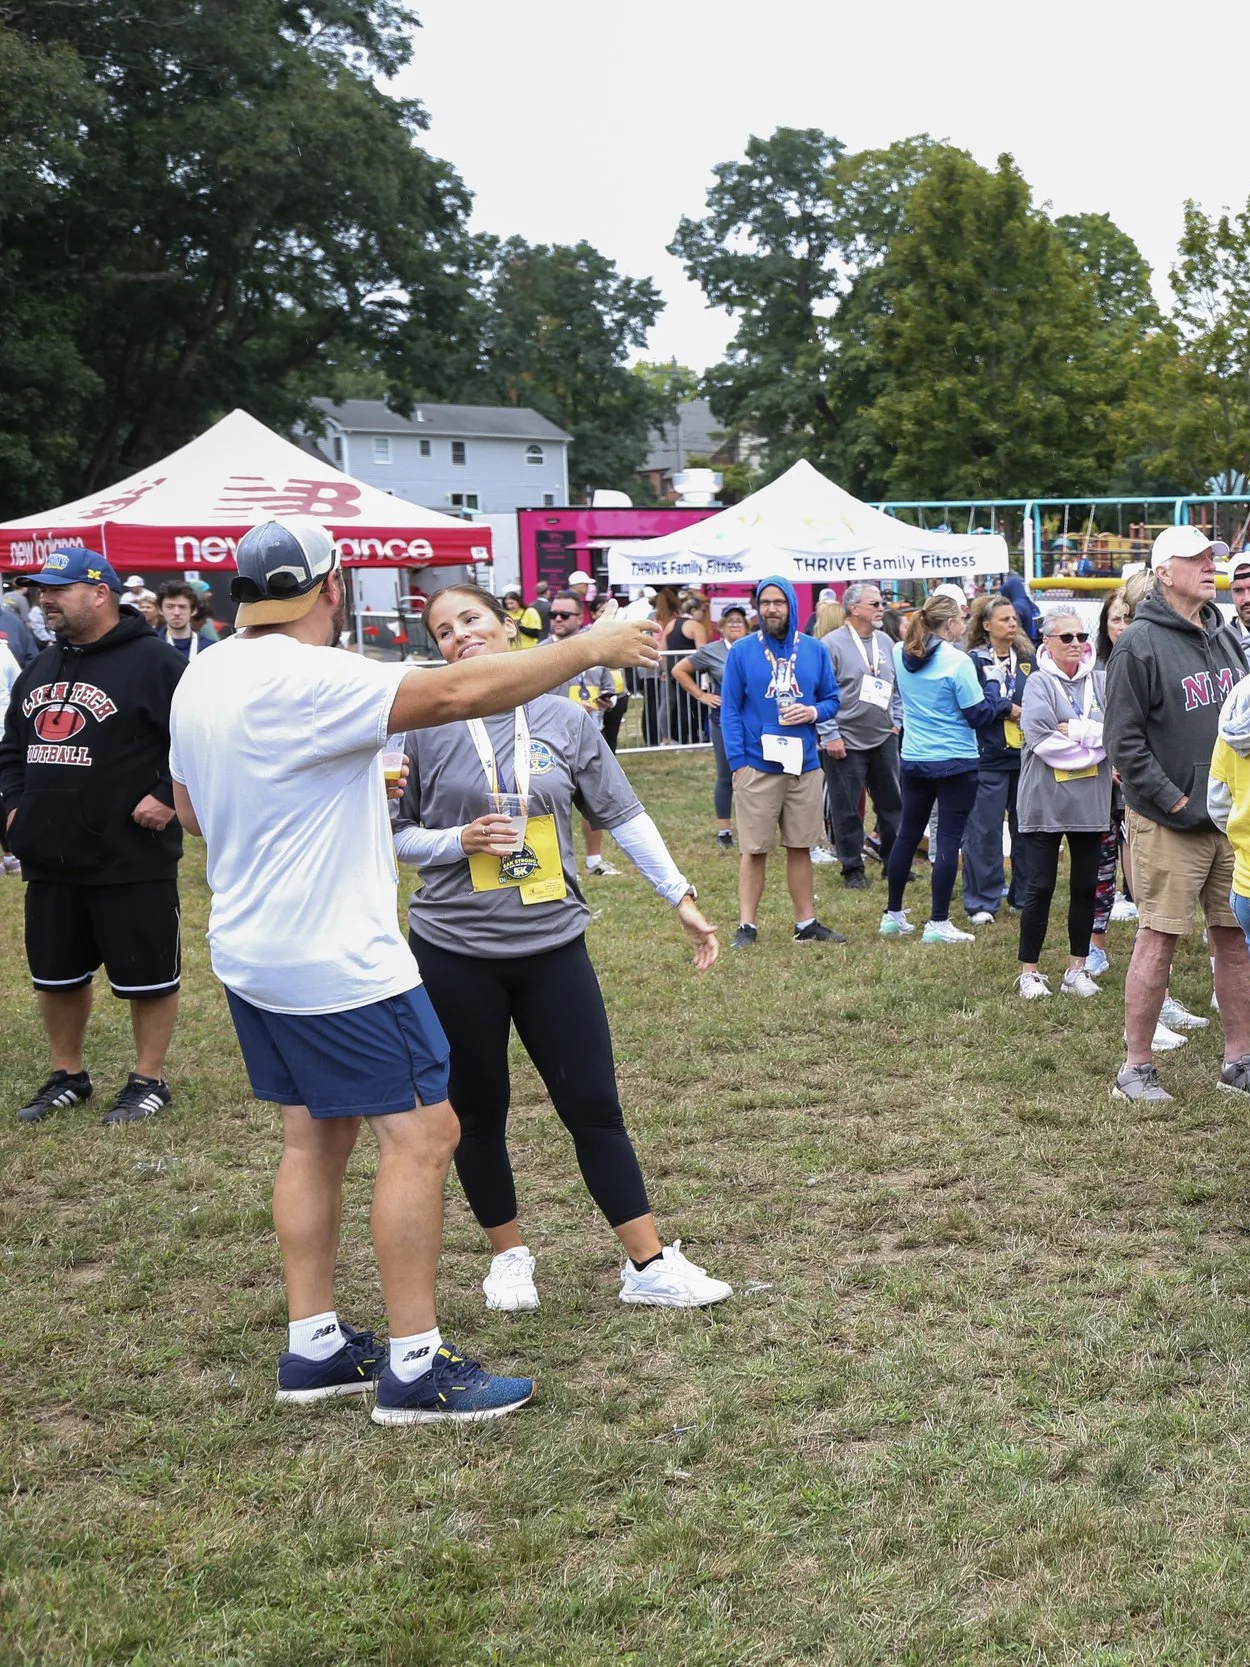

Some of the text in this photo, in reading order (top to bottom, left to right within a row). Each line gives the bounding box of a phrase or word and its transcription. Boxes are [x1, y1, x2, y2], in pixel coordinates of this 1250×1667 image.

[10, 541, 34, 566] new
[335, 538, 434, 562] ance
[632, 559, 743, 577] THRIVE Family Fitness
[793, 554, 976, 572] THRIVE Family Fitness
[69, 682, 118, 722] TECH
[513, 866, 528, 876] 5K
